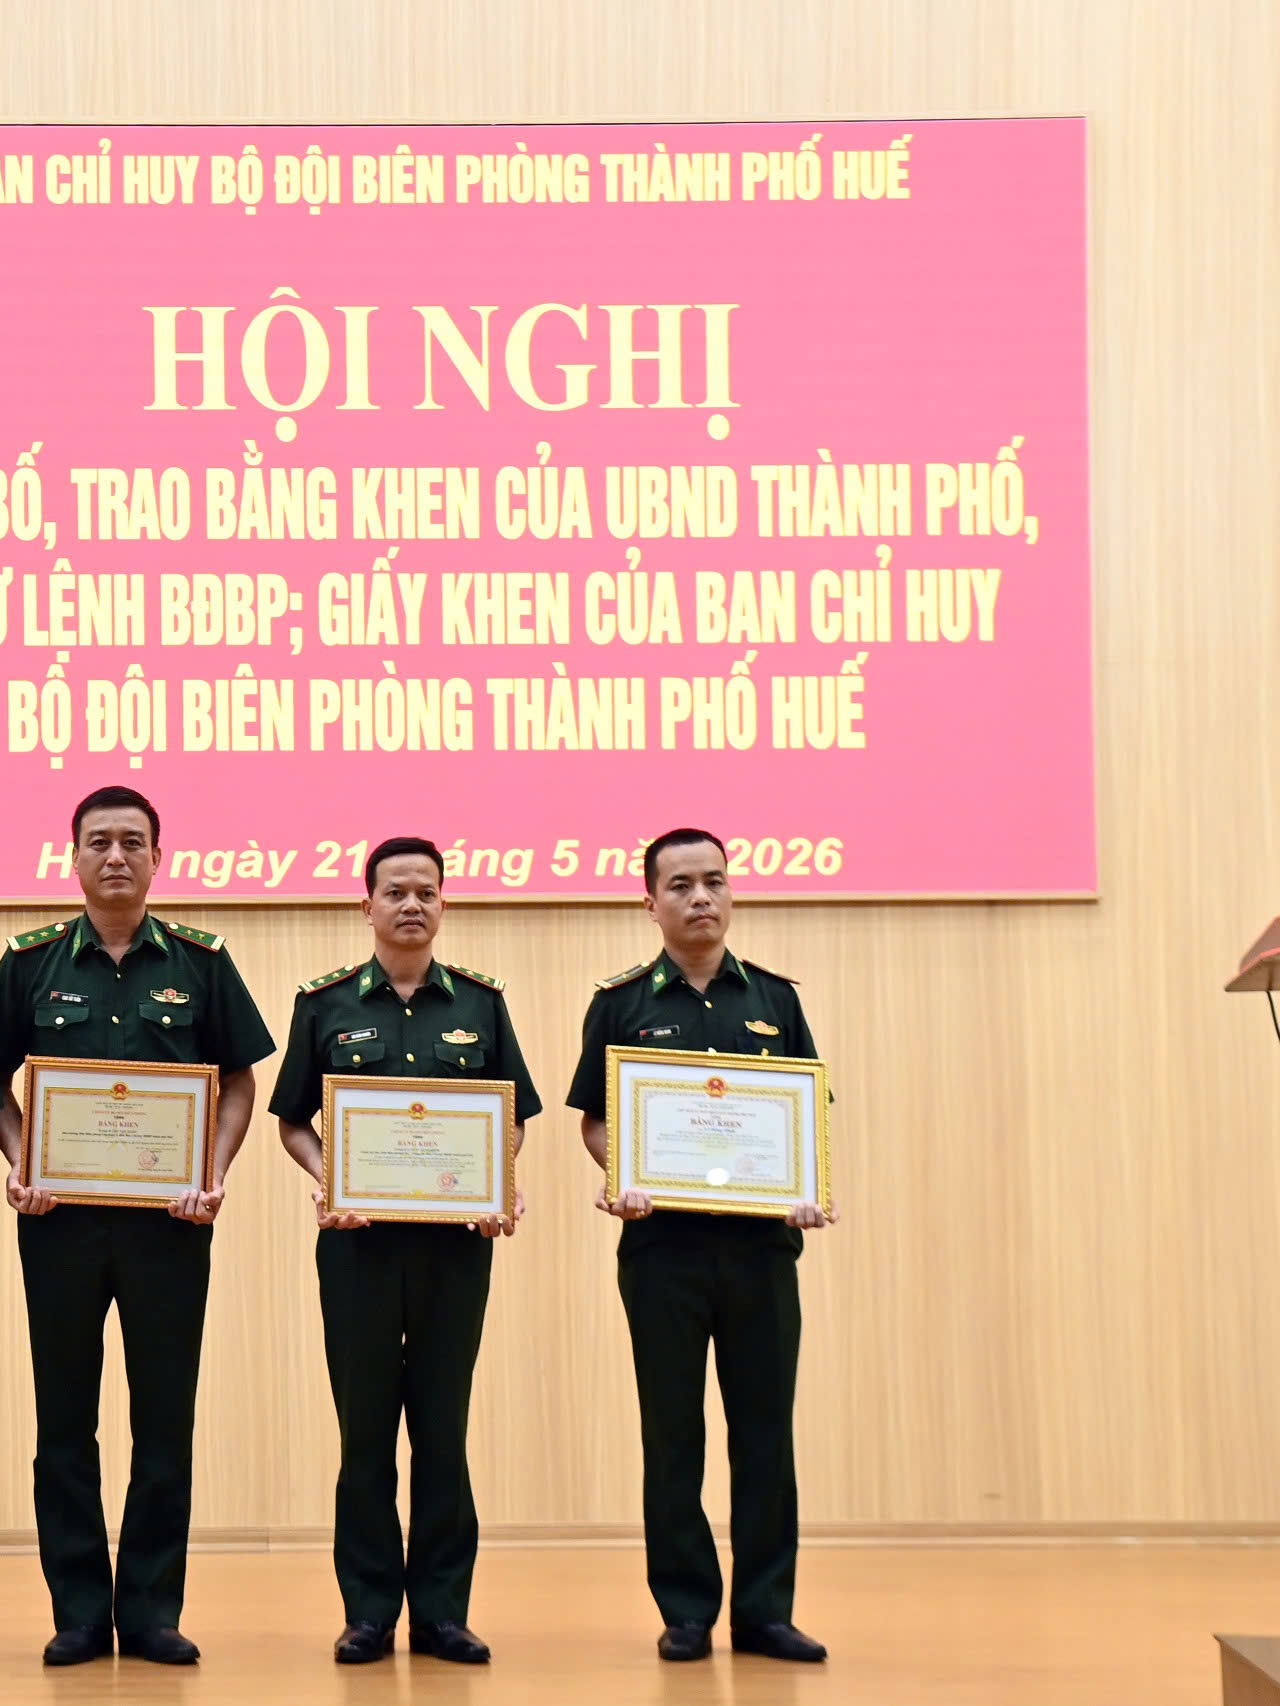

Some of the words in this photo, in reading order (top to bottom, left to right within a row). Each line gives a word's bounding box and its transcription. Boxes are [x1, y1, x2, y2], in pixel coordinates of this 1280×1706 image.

[45, 137, 112, 205] CHỈ
[123, 155, 200, 205] HUY
[210, 144, 264, 216] BỘ
[273, 144, 341, 216] ĐỘI
[352, 144, 445, 204] BIÊN
[455, 141, 590, 204] PHÒNG
[599, 142, 731, 203] THÀNH
[741, 132, 823, 201] PHỐ
[832, 133, 913, 201] HUẾ
[142, 286, 381, 443] HỘI
[412, 302, 741, 441] NGHỊ
[70, 466, 191, 541] TRAO
[205, 439, 337, 541] BẰNG
[351, 467, 481, 540] KHEN
[495, 441, 593, 540] CỦA
[605, 465, 738, 540] UBND
[750, 447, 912, 538] THÀNH
[925, 435, 1039, 545] PHỐ,
[23, 557, 145, 664] LỆNH
[160, 573, 303, 656] BĐBP;
[318, 546, 428, 647] GIẤY
[441, 572, 570, 645] KHEN
[584, 546, 684, 646] CỦA
[695, 570, 797, 644] BAN
[810, 543, 893, 644] CHỈ
[905, 568, 1002, 643] HUY
[7, 663, 72, 770] BỘ
[85, 663, 167, 769] ĐỘI
[182, 663, 295, 752] BIÊN
[309, 660, 474, 752] PHÒNG
[486, 661, 646, 751] THÀNH
[660, 649, 758, 751] PHỐ
[771, 651, 869, 750] HUẾ
[169, 839, 298, 889] ngày
[312, 839, 368, 878] 21
[441, 838, 535, 887] áng
[550, 839, 580, 877] 5
[594, 837, 655, 877] nă
[725, 837, 844, 876] 2026
